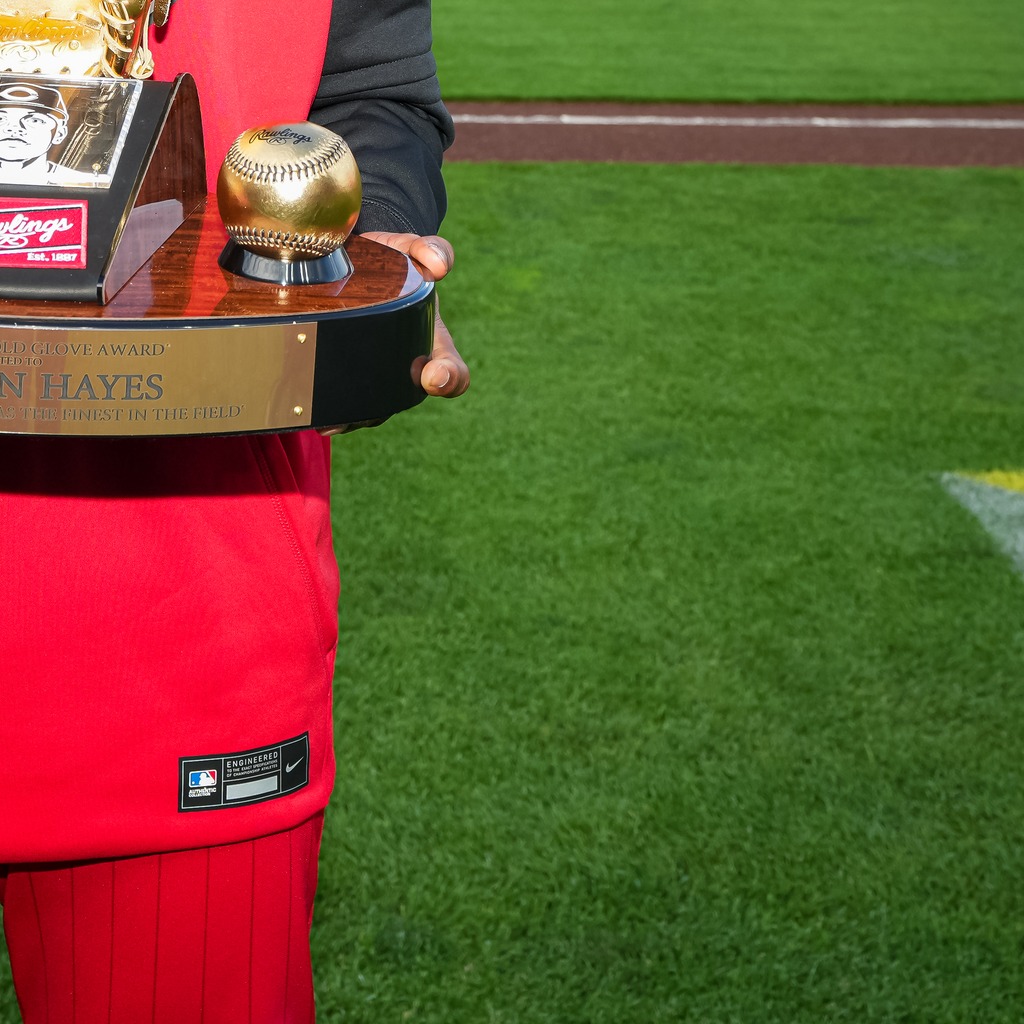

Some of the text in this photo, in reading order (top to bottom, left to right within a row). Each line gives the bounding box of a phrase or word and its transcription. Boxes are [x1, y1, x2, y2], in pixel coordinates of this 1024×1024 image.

[249, 128, 312, 144] Rawlings
[27, 252, 50, 262] Est.
[31, 341, 93, 356] GLOVE
[25, 357, 43, 367] TO
[40, 372, 164, 401] HAYES
[20, 407, 57, 421] THE
[62, 408, 124, 422] FINEST
[128, 408, 147, 421] IN
[152, 408, 189, 421] THE
[226, 751, 278, 768] ENGINEERED
[233, 768, 260, 777] CHAMPIONSHIP
[261, 763, 278, 772] ATHLETES
